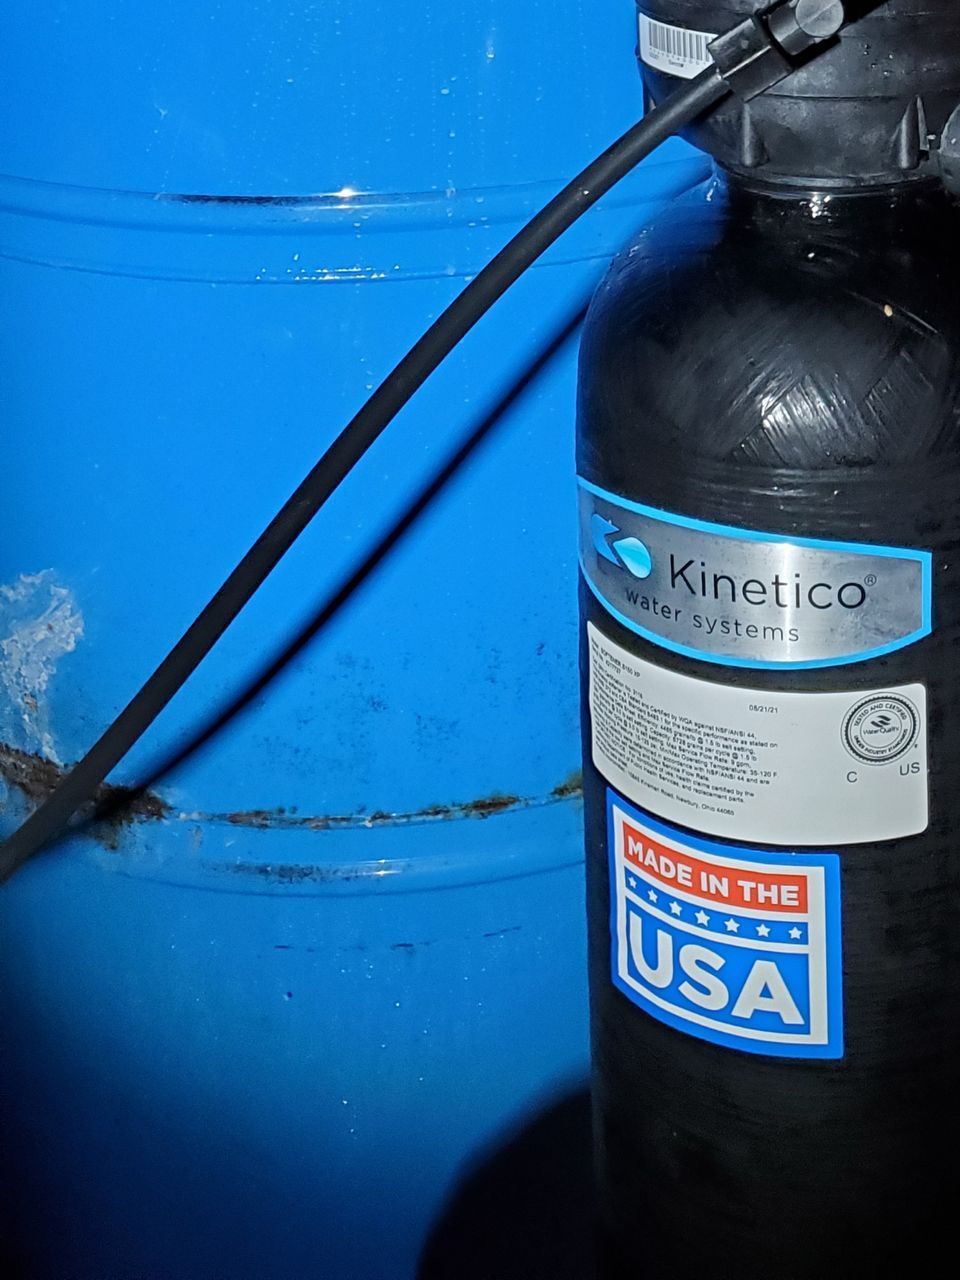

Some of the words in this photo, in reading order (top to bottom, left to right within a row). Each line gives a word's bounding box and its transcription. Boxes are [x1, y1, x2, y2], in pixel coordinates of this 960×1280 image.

[669, 553, 867, 609] Kinetico
[624, 588, 683, 622] water
[692, 613, 800, 642] systems
[846, 770, 858, 783] C
[899, 761, 921, 776] US
[627, 835, 693, 888] MADE
[700, 871, 730, 898] IN
[736, 880, 801, 907] THE
[629, 910, 806, 1026] USA
